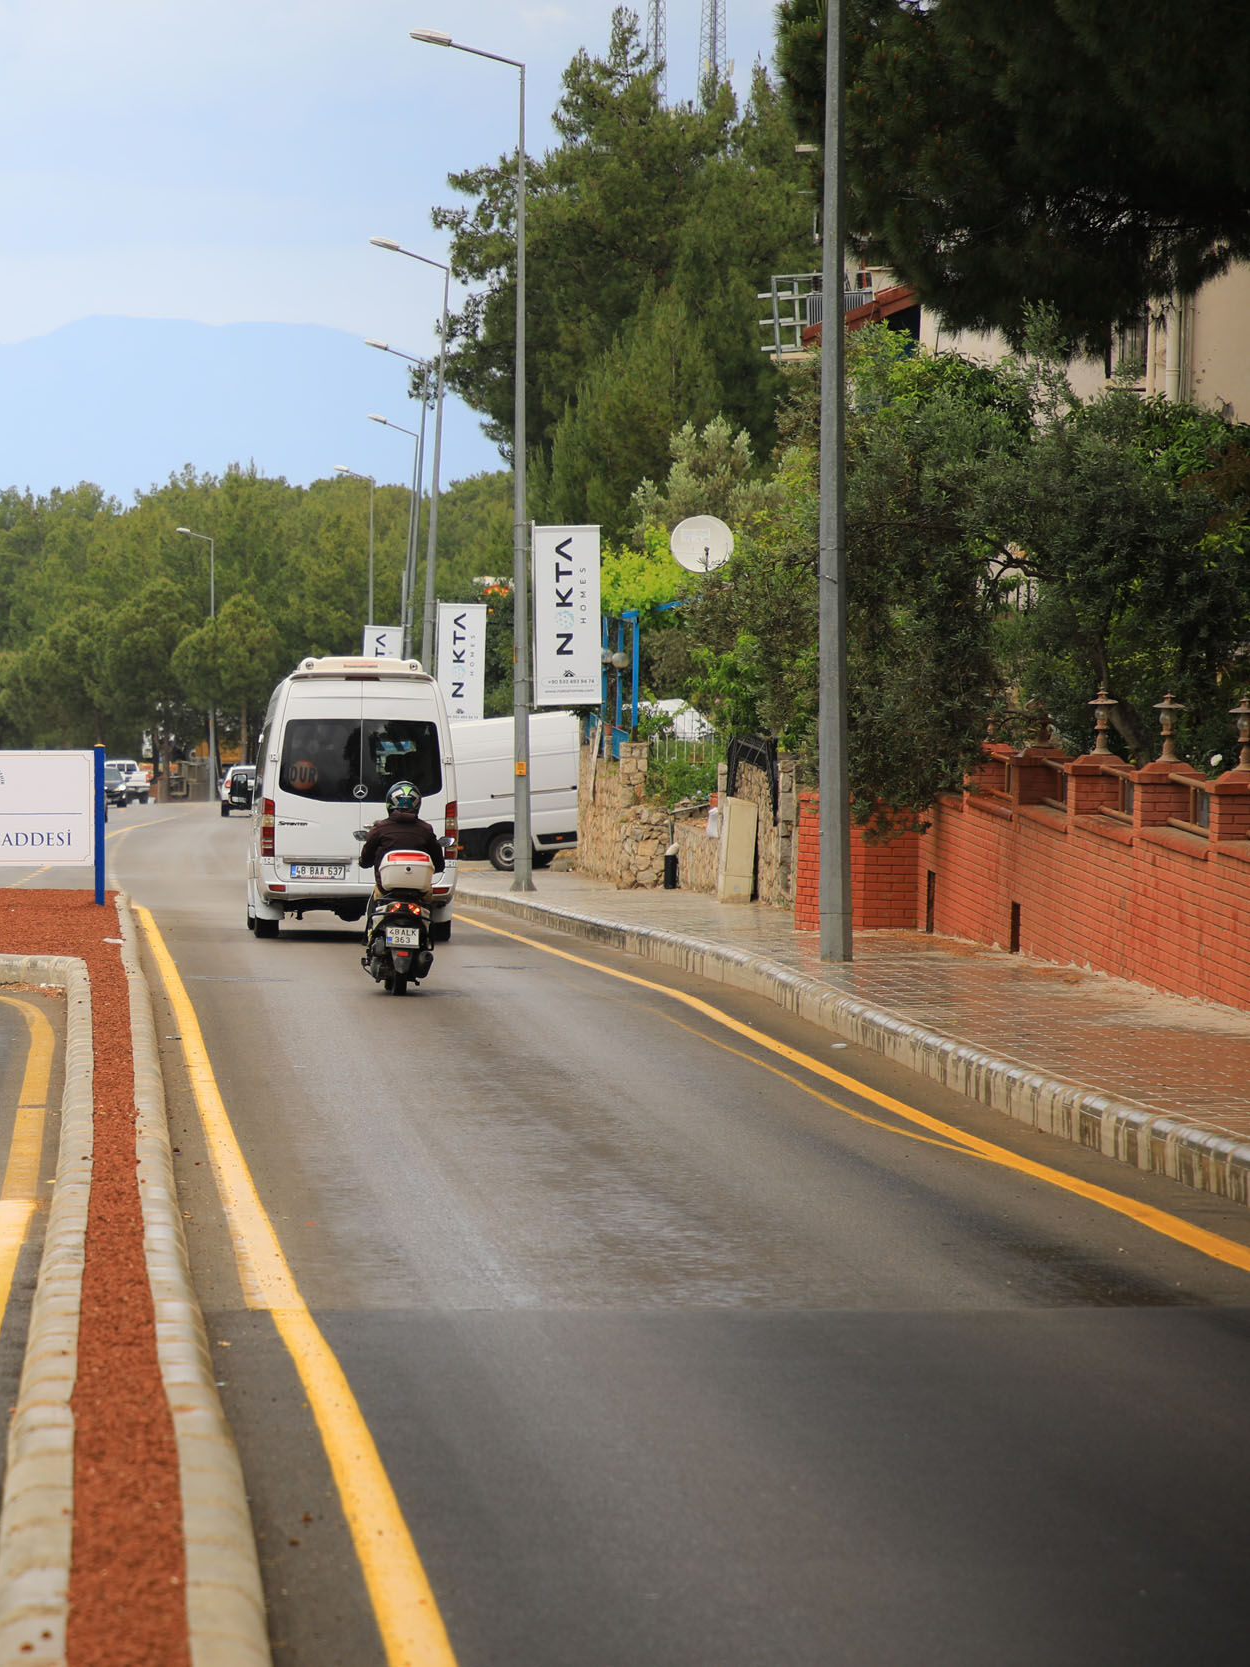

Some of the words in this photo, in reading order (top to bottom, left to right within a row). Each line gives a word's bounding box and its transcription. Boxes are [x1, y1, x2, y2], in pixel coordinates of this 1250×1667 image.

[579, 568, 587, 623] HOMES
[296, 866, 306, 875] 48
[310, 866, 325, 875] BAA
[328, 867, 343, 876] 637
